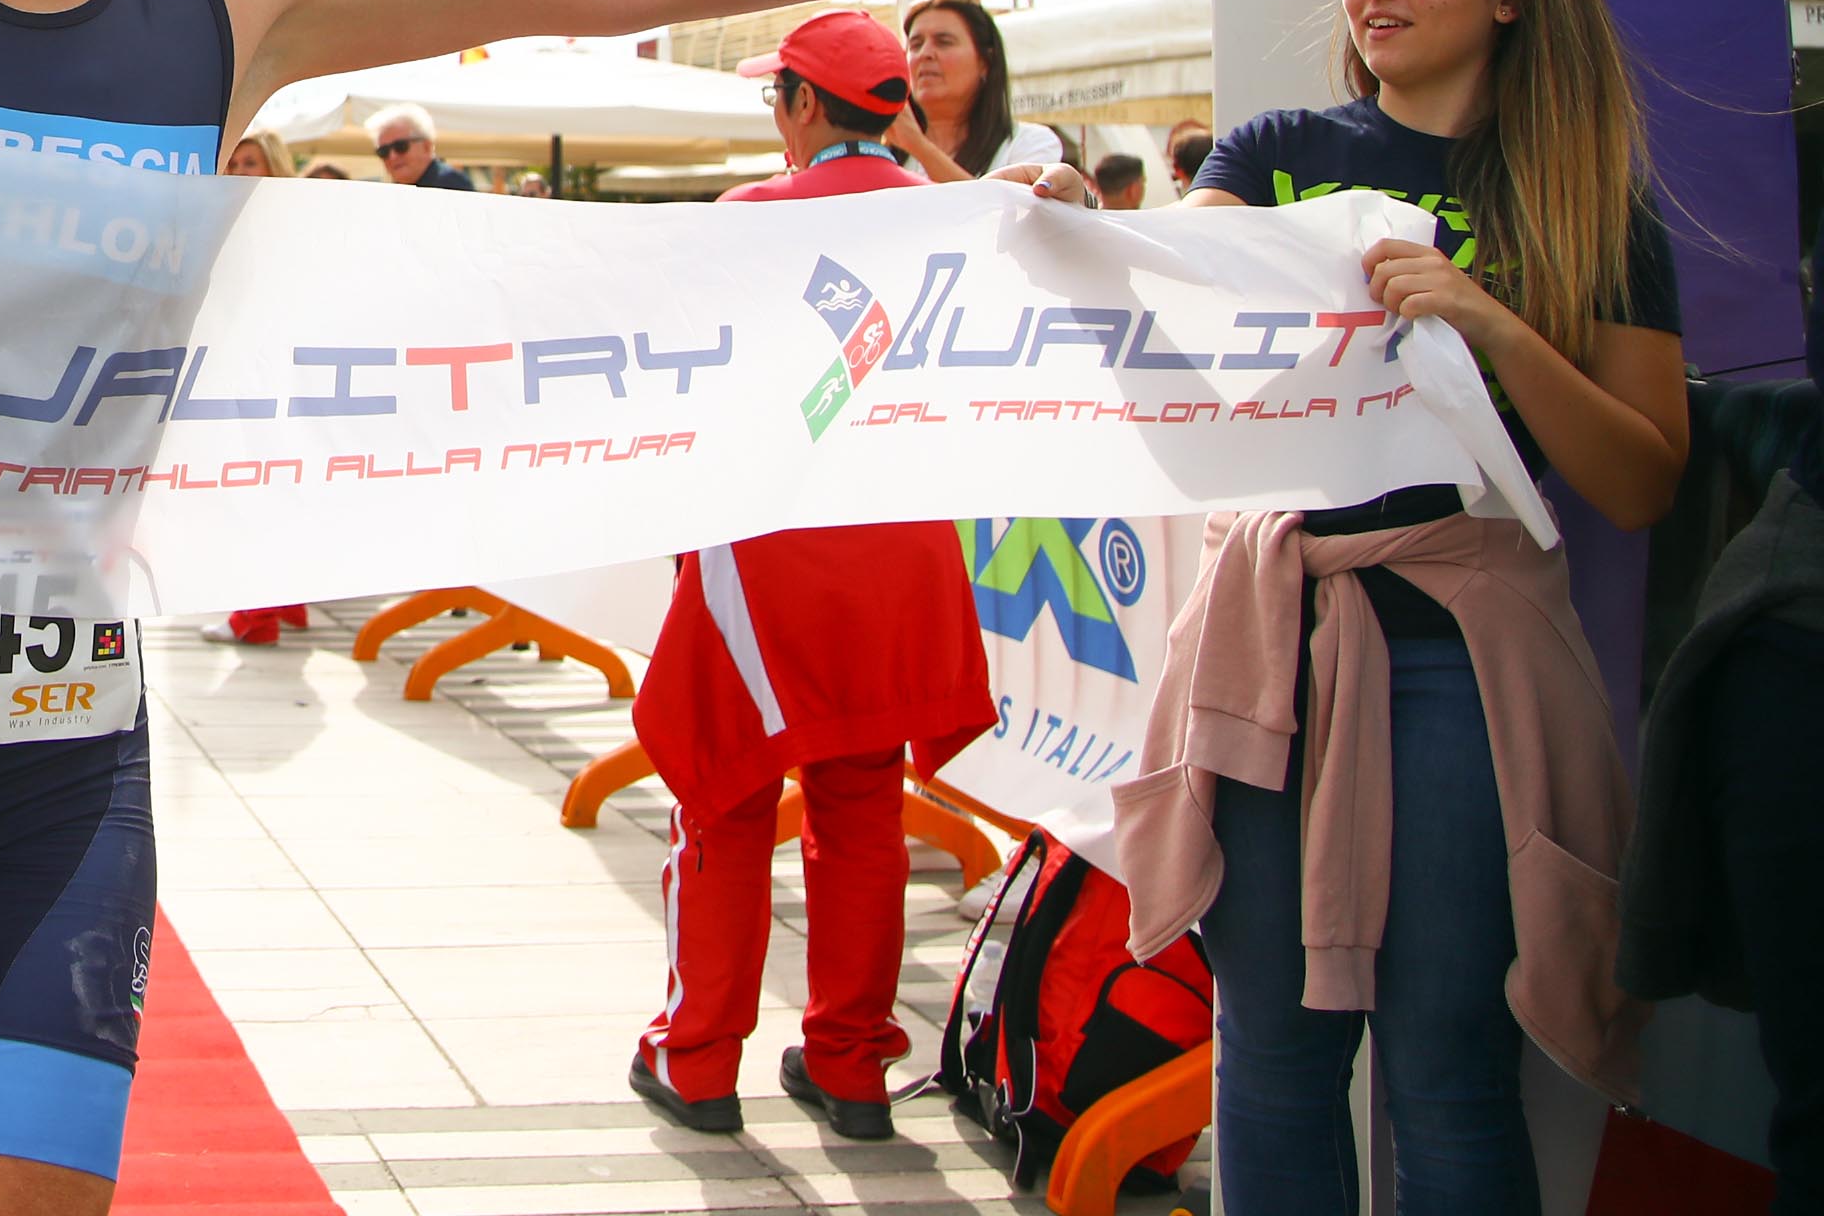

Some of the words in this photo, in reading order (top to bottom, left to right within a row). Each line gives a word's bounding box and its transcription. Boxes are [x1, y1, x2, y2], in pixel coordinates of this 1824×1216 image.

[968, 399, 1221, 424] TRIATHLON
[1229, 398, 1337, 421] ALLA
[326, 448, 482, 481] ALLA
[501, 431, 697, 470] NATURA
[9, 682, 96, 716] SER
[8, 718, 32, 729] Wax
[39, 714, 92, 726] Industry
